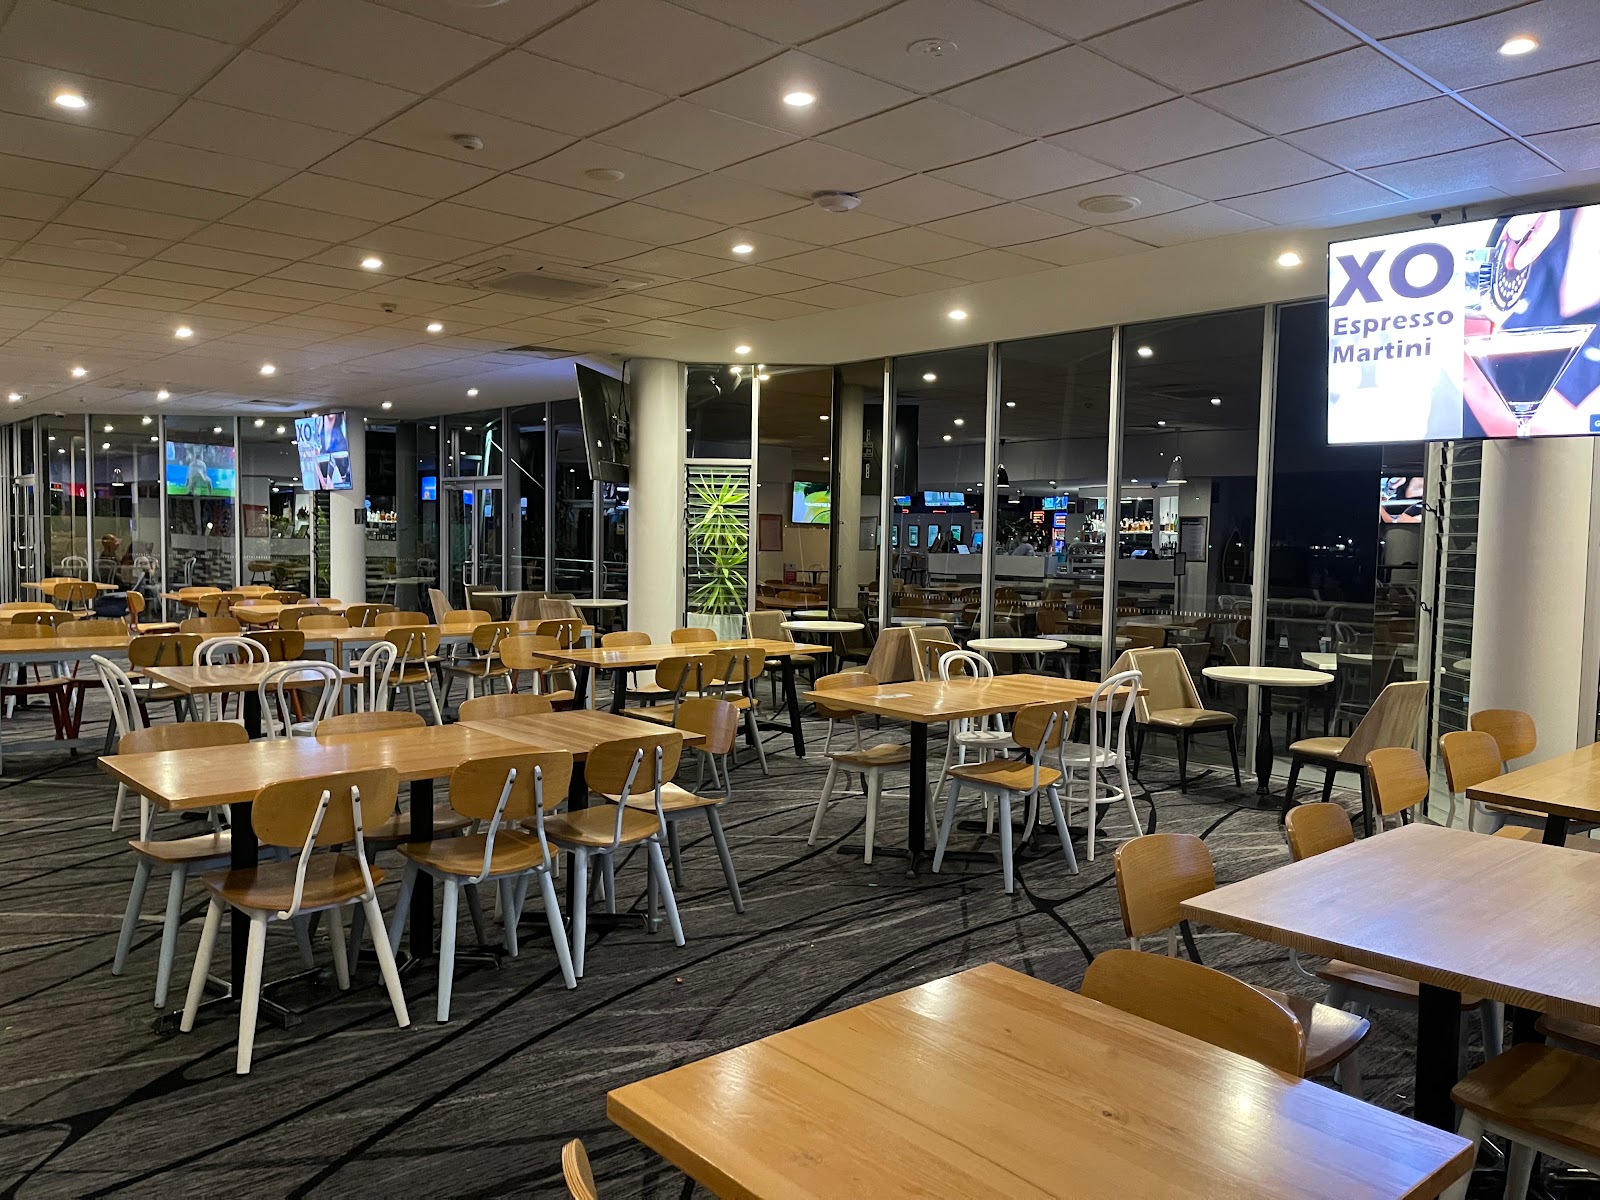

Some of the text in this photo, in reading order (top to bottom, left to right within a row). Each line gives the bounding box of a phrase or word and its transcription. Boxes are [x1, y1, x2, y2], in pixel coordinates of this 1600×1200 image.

[1329, 242, 1455, 307] XO
[1333, 309, 1455, 338] Espresso
[1332, 337, 1432, 364] Martini
[296, 423, 312, 442] XO
